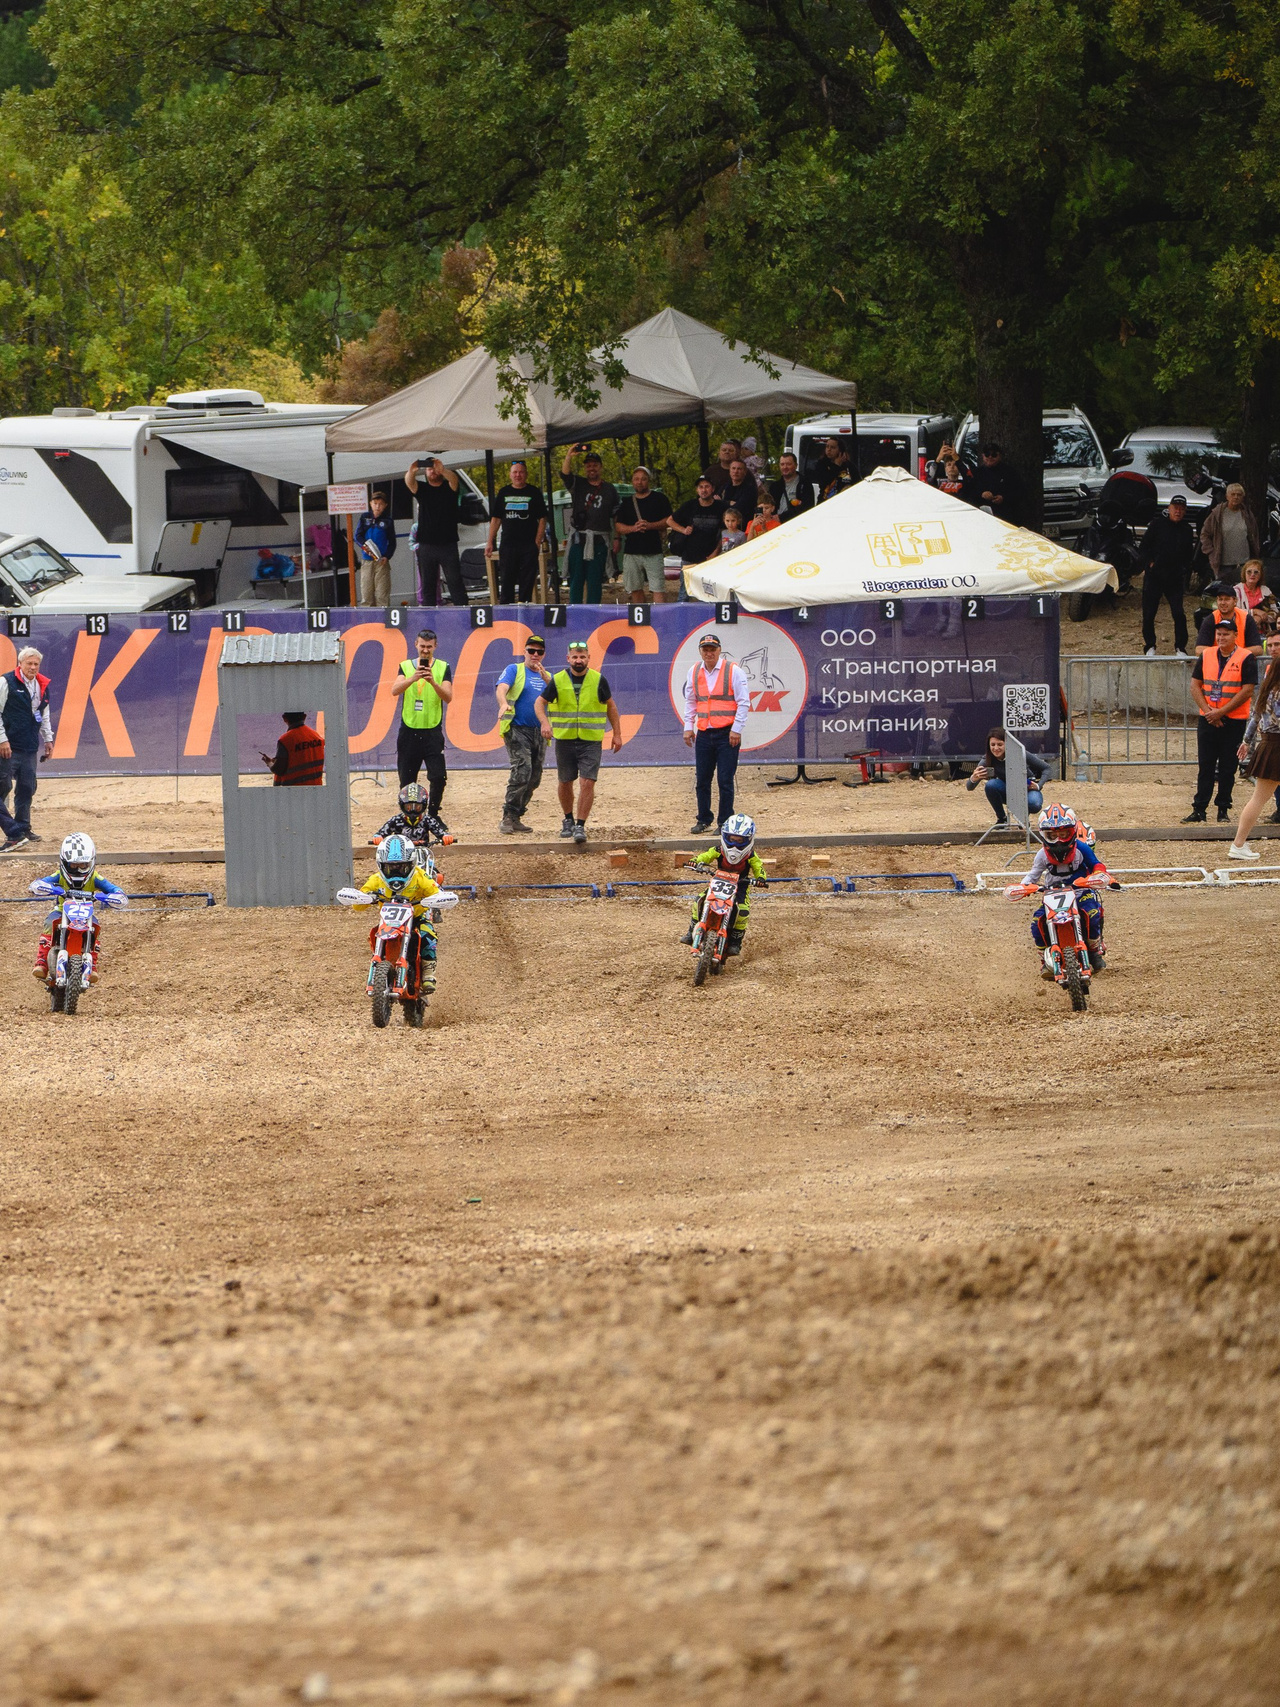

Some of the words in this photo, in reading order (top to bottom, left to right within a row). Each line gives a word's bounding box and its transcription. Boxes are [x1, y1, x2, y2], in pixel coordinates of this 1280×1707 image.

[863, 578, 948, 593] Hoegaarden
[722, 605, 730, 621] 5
[799, 607, 808, 619] 4
[886, 602, 894, 618] 3
[968, 600, 976, 616] 2
[1038, 598, 1043, 614] 1
[171, 614, 186, 630] 12
[226, 613, 240, 629] 11
[311, 611, 327, 627] 10
[391, 610, 400, 626] 9
[477, 609, 485, 625] 8
[550, 608, 558, 624] 7
[635, 607, 643, 623] 6
[11, 618, 27, 634] 14
[90, 616, 105, 632] 13
[821, 628, 876, 647] ООО
[821, 657, 996, 678] «Транспортная
[822, 687, 938, 707] Крымская
[822, 715, 948, 733] компания»
[712, 881, 736, 895] 33
[1054, 895, 1066, 909] 7
[68, 904, 90, 917] 25
[384, 907, 407, 920] 31
